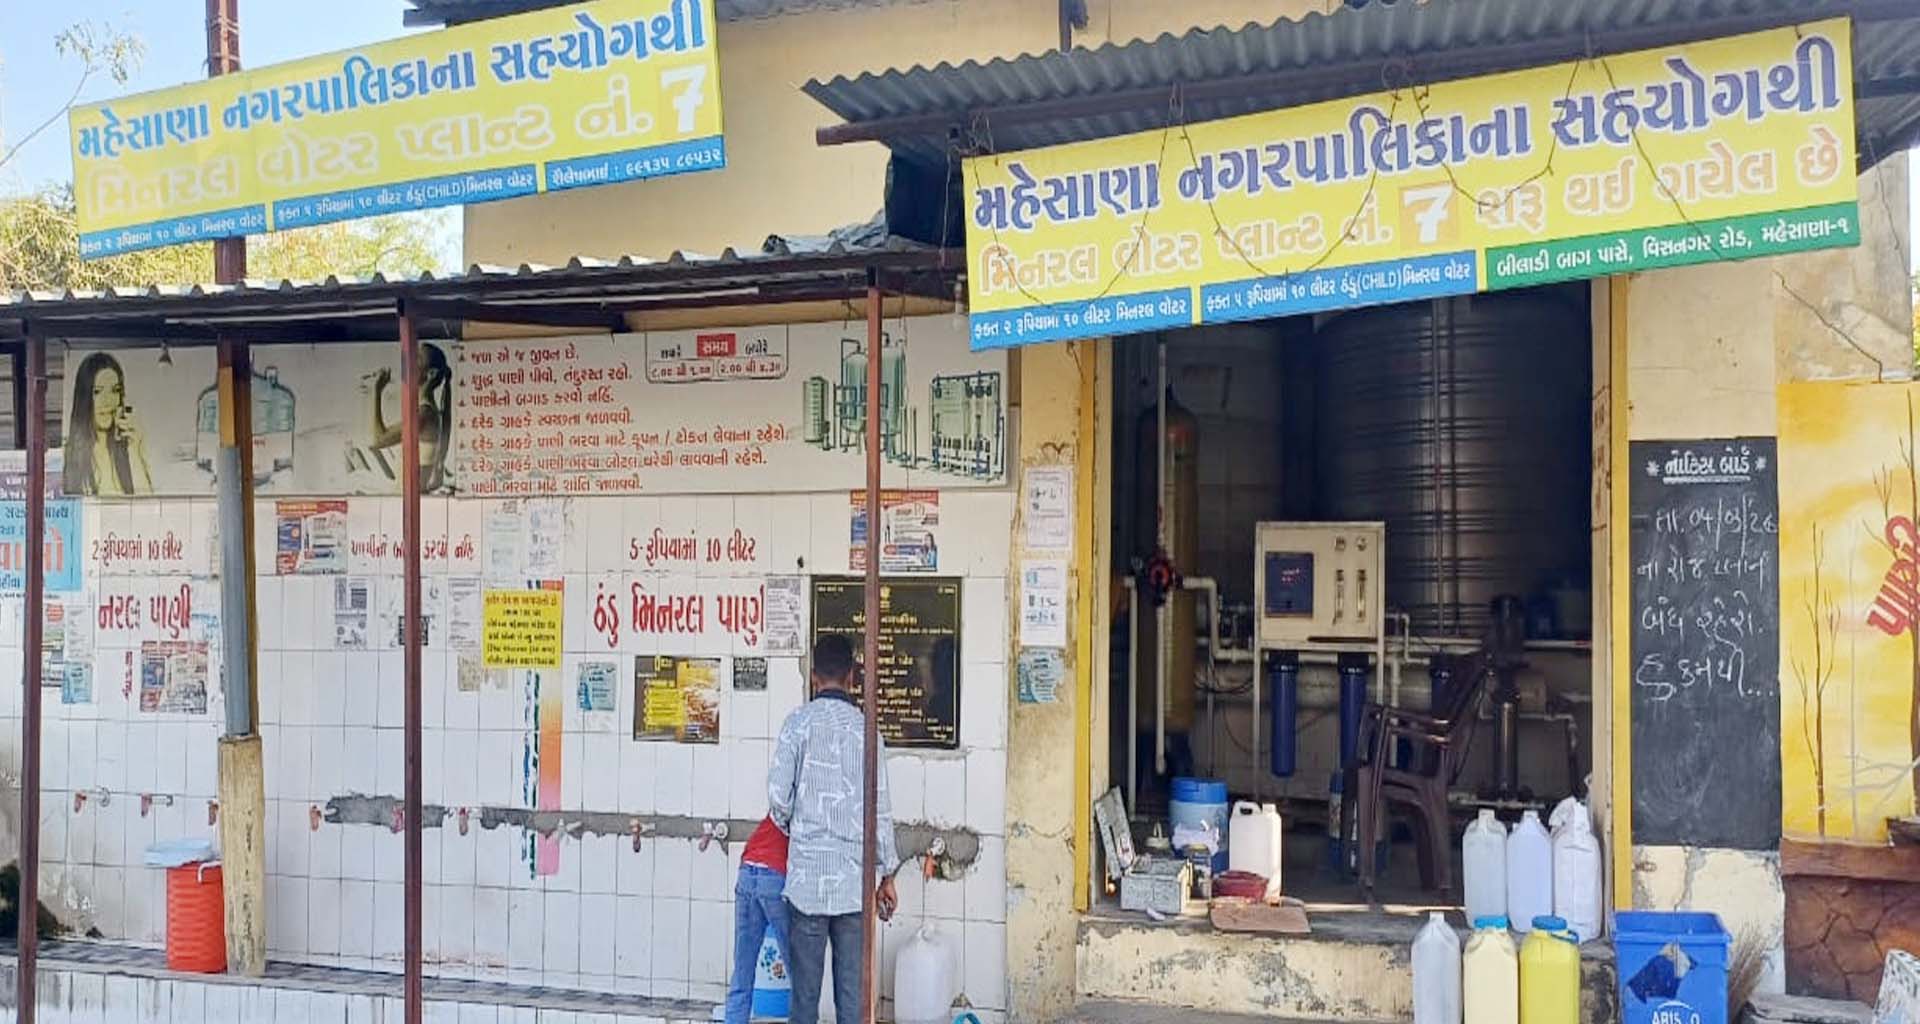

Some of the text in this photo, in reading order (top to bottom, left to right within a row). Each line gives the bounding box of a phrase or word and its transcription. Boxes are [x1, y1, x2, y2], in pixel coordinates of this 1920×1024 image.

[78, 0, 705, 158] મહેસાણા નગરપાલિકાના સહયોગથી
[86, 65, 707, 221] મિનરલ વોટર પ્લાન્ટ નં. 7
[974, 36, 1840, 231] મહેસાણા નગરપાલિકાના સહયોગથી
[508, 170, 534, 187] વોટર
[202, 218, 235, 233] મિનરલ
[240, 213, 265, 228] વોટર
[979, 126, 1842, 296] મિનરલ વોટર પ્લાન્ટ નં. 7 શરૂ થઈ ગયેલ છે
[1497, 248, 1550, 277] બીલાડી
[1556, 247, 1590, 268] બાગ
[1597, 239, 1633, 264] પાસે,
[1643, 231, 1710, 259] વિસનગર
[1718, 226, 1752, 250] રોડ,
[1292, 287, 1305, 300] ૧૦
[1310, 276, 1336, 298] લીટર
[1444, 259, 1471, 280] વોટર
[1064, 314, 1079, 328] ૧૦
[1083, 304, 1112, 326] લીટર
[1116, 301, 1154, 321] મિનરલ
[1159, 297, 1187, 316] વોટર
[498, 368, 524, 385] પાણી
[706, 538, 721, 563] 10
[727, 527, 756, 562] લીટર
[149, 583, 191, 640] પાણી
[631, 581, 704, 634] મિનરલ
